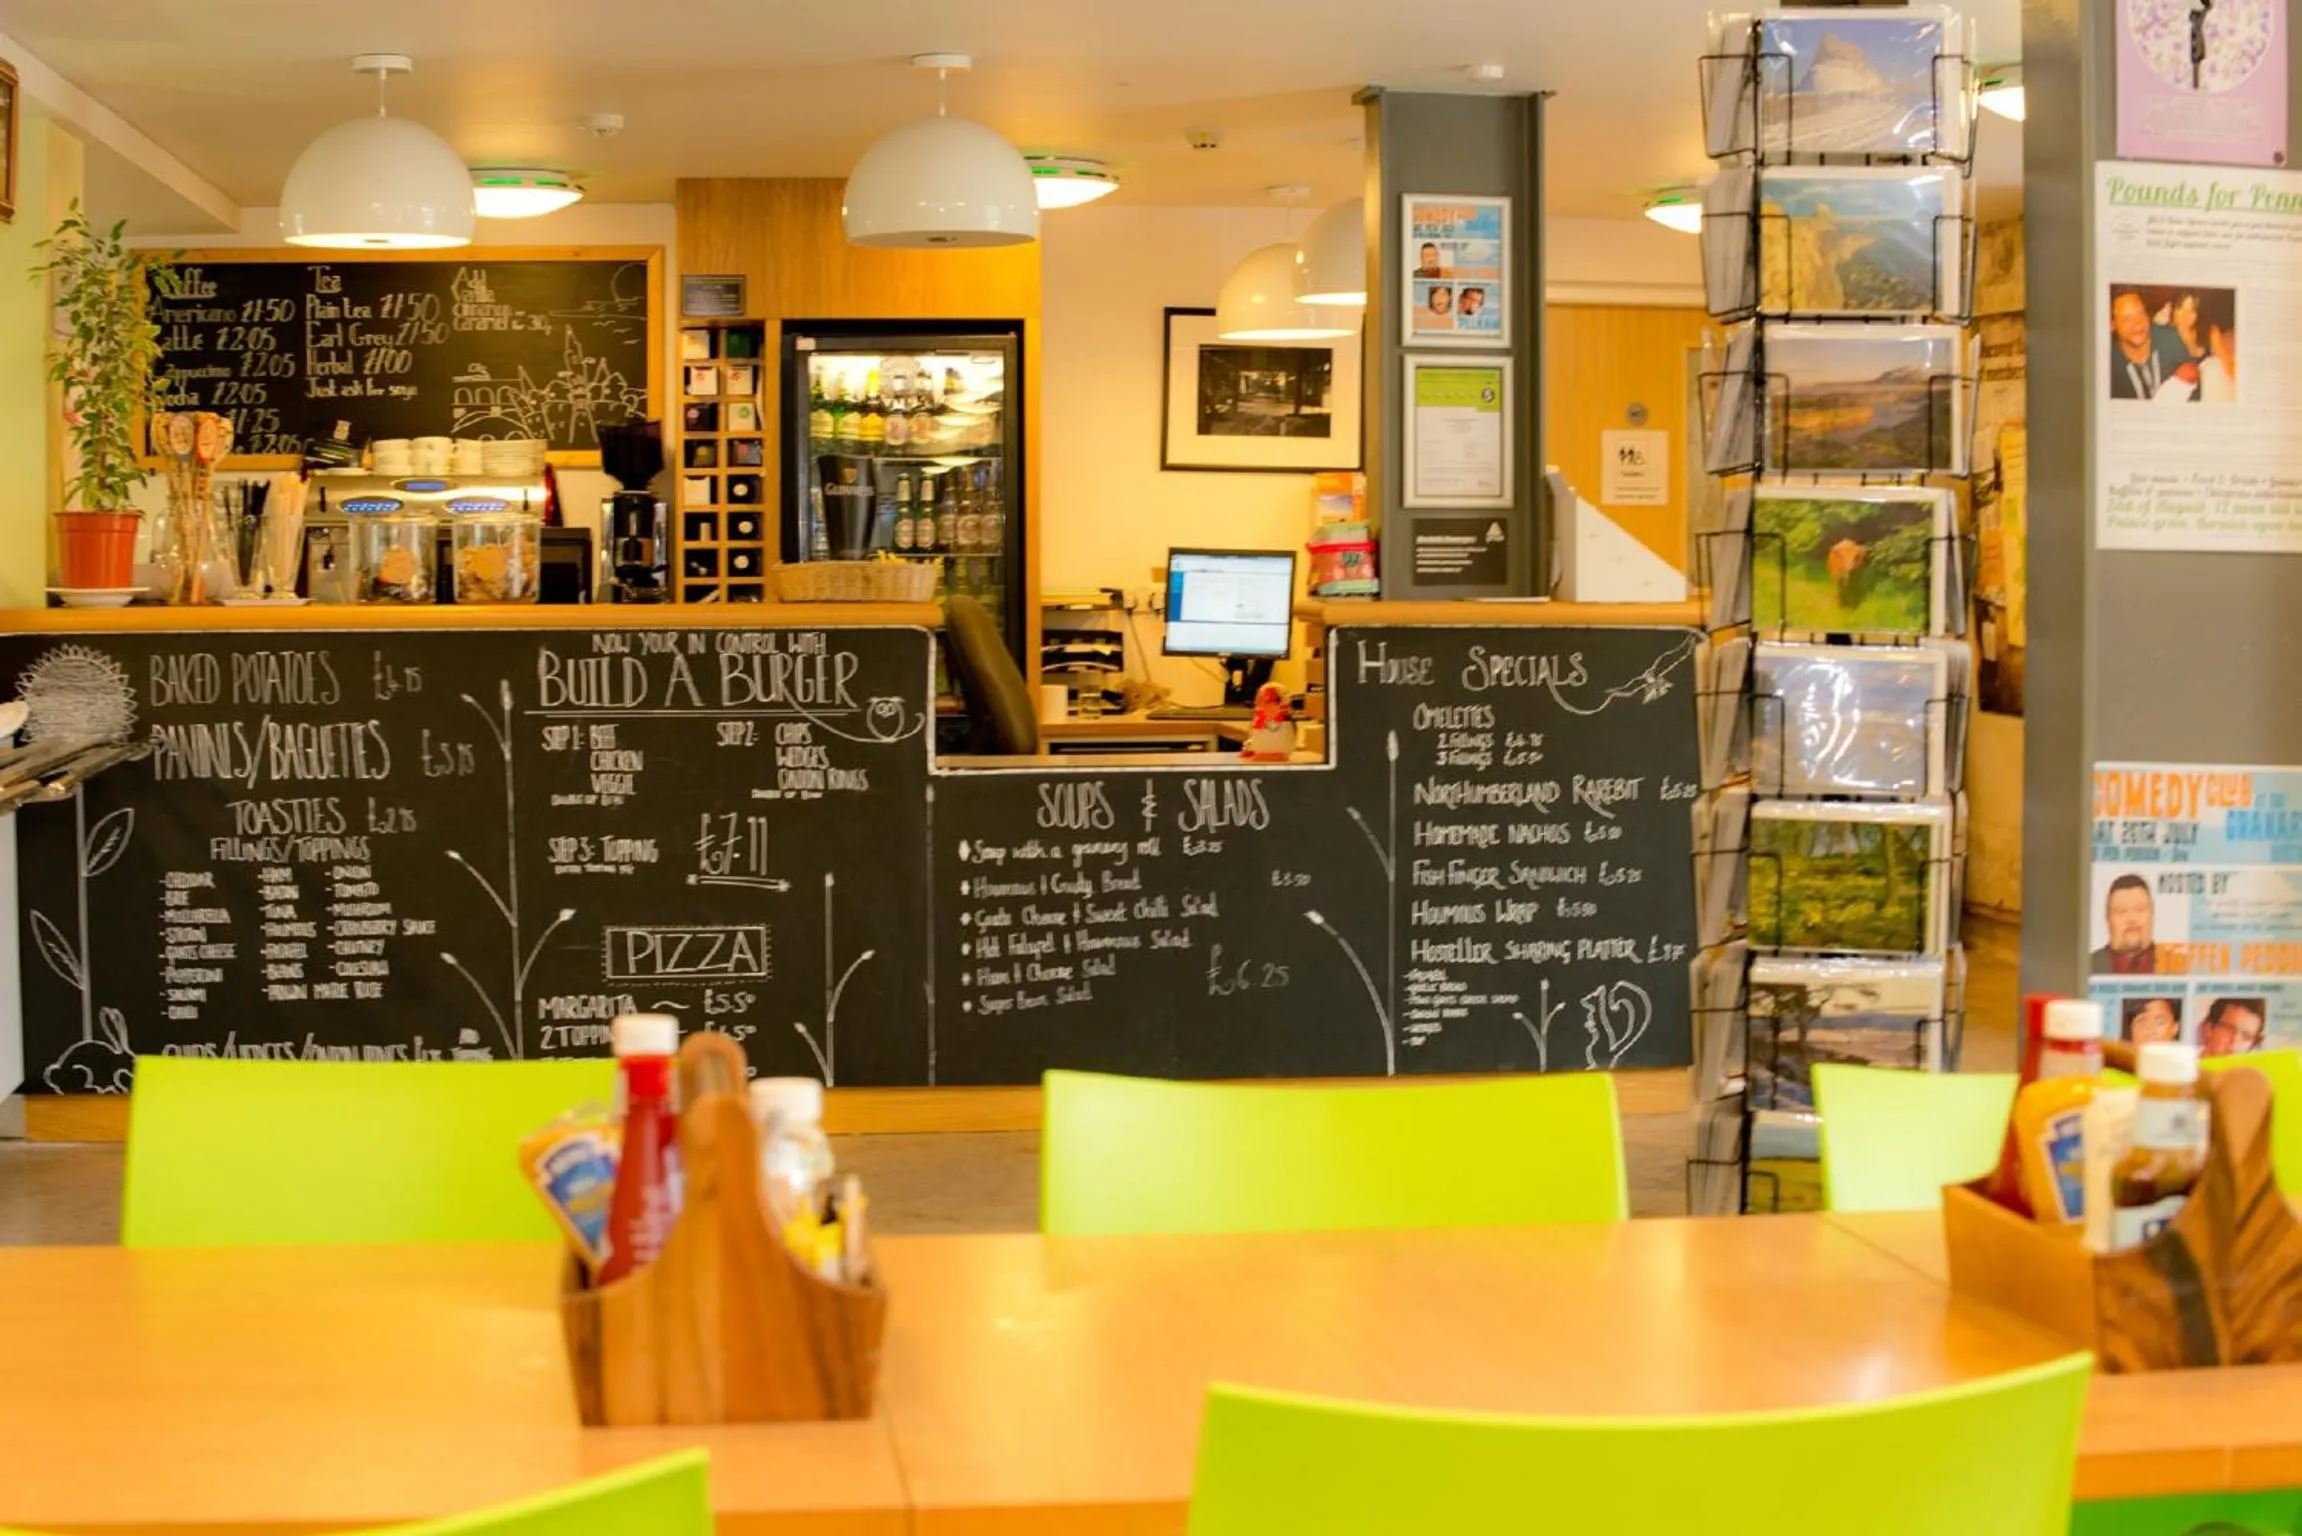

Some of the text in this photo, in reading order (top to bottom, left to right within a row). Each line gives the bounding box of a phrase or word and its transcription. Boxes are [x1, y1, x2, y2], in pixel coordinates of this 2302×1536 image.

[2107, 177, 2199, 205] Pounds
[2205, 181, 2242, 212] for
[308, 265, 343, 294] Tea
[305, 293, 341, 320] Plain
[162, 324, 205, 351] atte
[306, 321, 344, 348] Earl
[165, 387, 202, 407] ocha
[638, 632, 679, 656] YOUR
[150, 653, 222, 706] BAKED
[232, 651, 342, 706] POTATOES
[538, 647, 861, 709] BUILD A BURGER
[1462, 644, 1589, 692] SPECIALS
[226, 797, 347, 836] TOASTIES
[1036, 780, 1116, 830] SOUPS
[1177, 778, 1270, 833] SALADS
[625, 928, 760, 976] PIZZA
